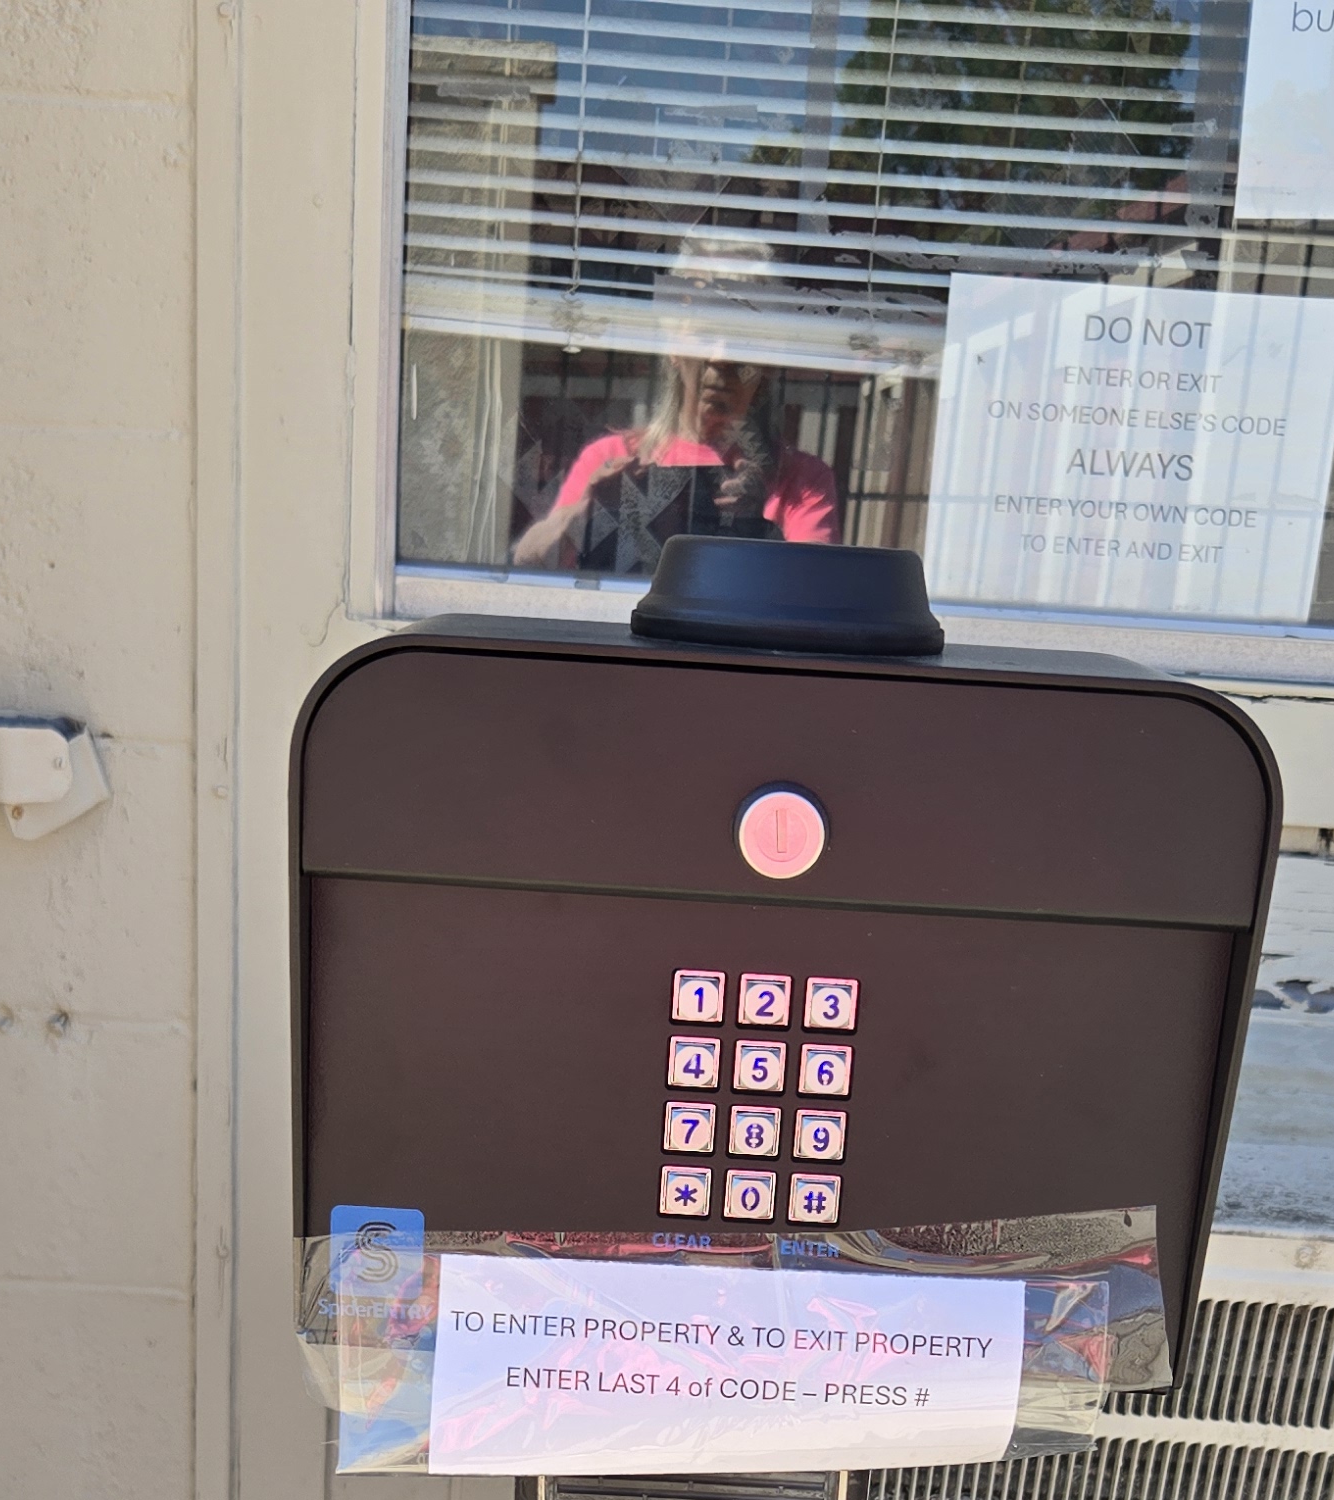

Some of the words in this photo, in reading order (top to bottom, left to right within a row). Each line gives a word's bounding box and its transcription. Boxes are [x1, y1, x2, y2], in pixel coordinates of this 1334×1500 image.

[1084, 315, 1133, 344] DO
[1142, 318, 1212, 350] NOT
[1063, 366, 1133, 389] ENTER
[1138, 371, 1171, 391] OR
[1176, 374, 1222, 393] EXIT
[987, 400, 1022, 419] ON
[1027, 402, 1139, 427] SOMEONE
[1144, 411, 1217, 432] ELSE'S
[1221, 416, 1287, 436] CODE
[1066, 448, 1194, 481] ALWAYS
[994, 495, 1063, 517] ENTER
[1067, 499, 1128, 521] YOUR
[1133, 503, 1188, 525] OWN
[1194, 507, 1258, 528] CODE
[1021, 534, 1047, 553] TO
[1052, 536, 1121, 557] ENTER
[1125, 542, 1173, 561] AND
[1178, 544, 1223, 564] EXIT
[693, 986, 704, 1013] 1
[756, 991, 776, 1018] 2
[823, 994, 840, 1021] 3
[682, 1053, 704, 1079] 4
[752, 1057, 768, 1083] 5
[817, 1060, 835, 1087] 6
[682, 1119, 700, 1145] 7
[746, 1123, 764, 1149] 8
[813, 1126, 830, 1153] 9
[741, 1186, 760, 1212] 0
[803, 1191, 827, 1214] #
[652, 1233, 712, 1249] CLEAR
[780, 1240, 840, 1257] ENTER
[451, 1311, 483, 1331] TO
[493, 1313, 576, 1338] ENTER
[584, 1318, 721, 1345] PROPERTY
[727, 1326, 744, 1347] &
[752, 1327, 785, 1348] TO
[794, 1329, 847, 1351] EXIT
[855, 1332, 992, 1358] PROPERTY
[507, 1367, 590, 1391] ENTER
[599, 1372, 660, 1395] LAST
[665, 1376, 680, 1396] 4
[688, 1377, 713, 1398] of
[720, 1378, 797, 1401] CODE
[824, 1383, 906, 1405] PRESS
[914, 1387, 930, 1407] #
